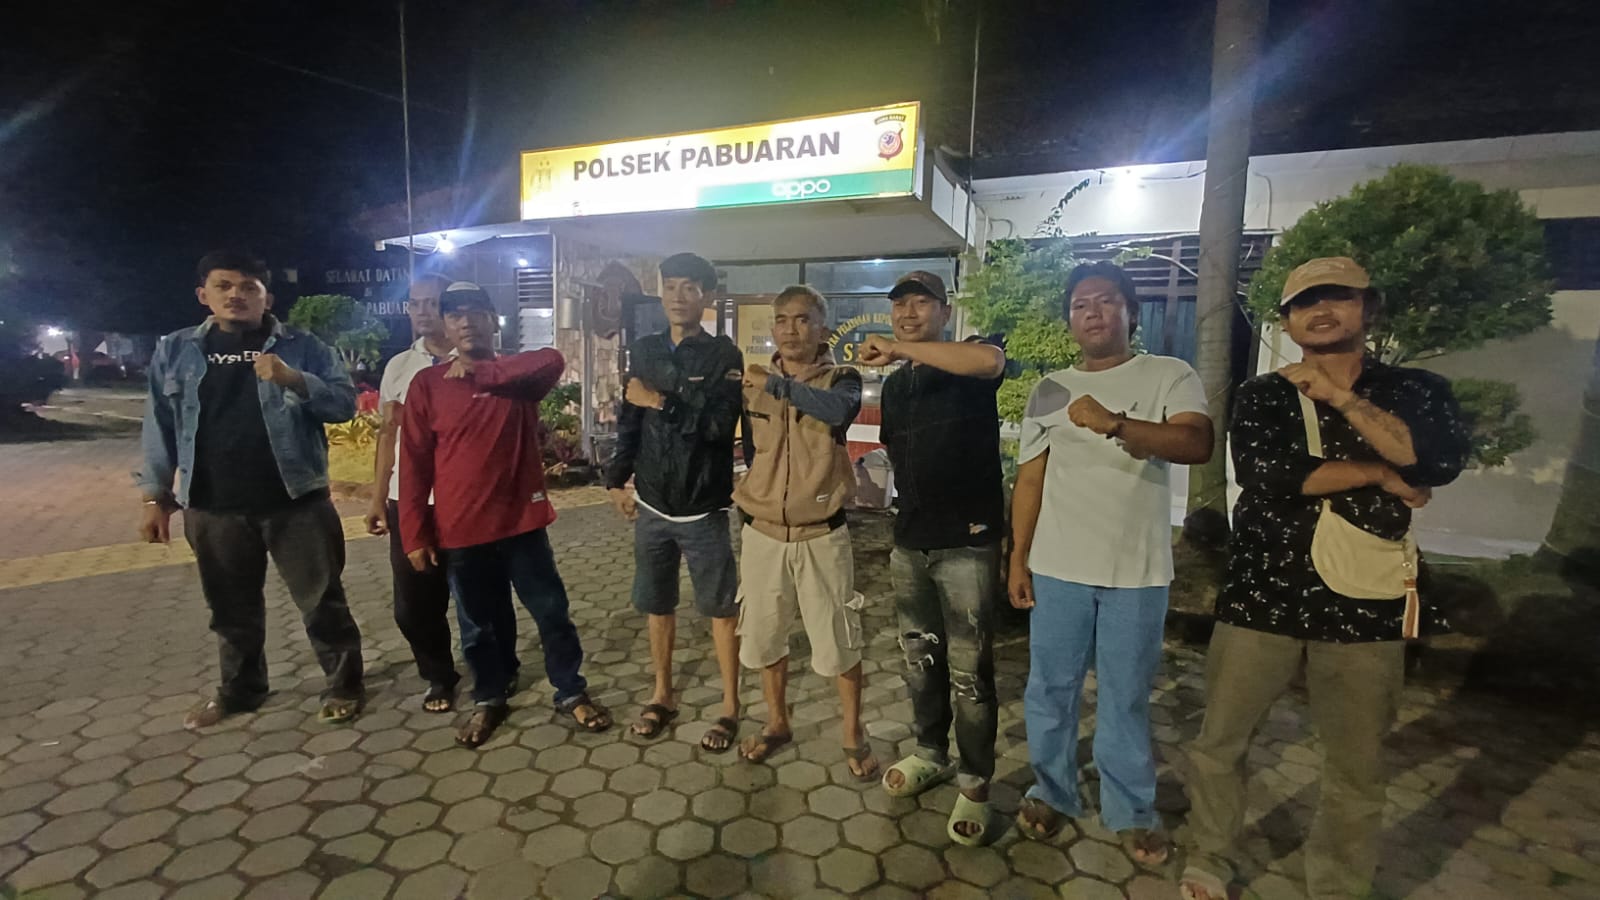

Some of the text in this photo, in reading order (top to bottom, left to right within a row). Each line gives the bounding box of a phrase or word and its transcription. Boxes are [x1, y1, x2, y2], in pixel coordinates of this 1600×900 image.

[573, 131, 841, 181] POLSEK PABUARAN
[375, 266, 410, 282] DATAN
[366, 301, 410, 315] PABUAR
